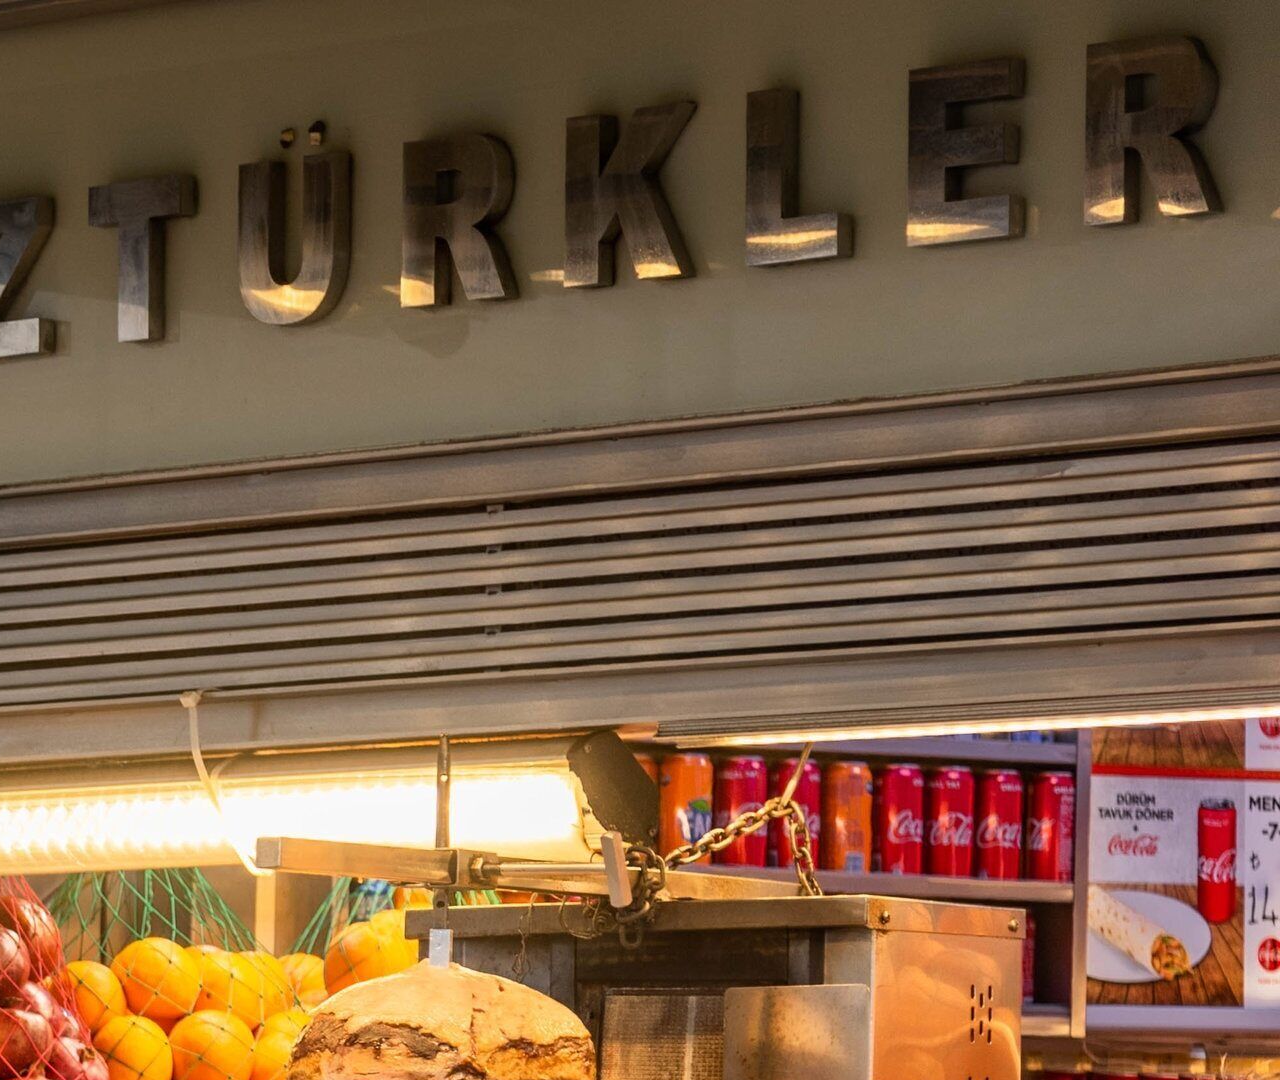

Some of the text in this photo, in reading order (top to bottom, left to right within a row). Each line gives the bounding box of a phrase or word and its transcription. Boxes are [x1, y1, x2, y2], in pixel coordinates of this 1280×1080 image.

[1116, 790, 1156, 806] DÜRÜM
[1098, 806, 1174, 821] TAVUK DÖNER
